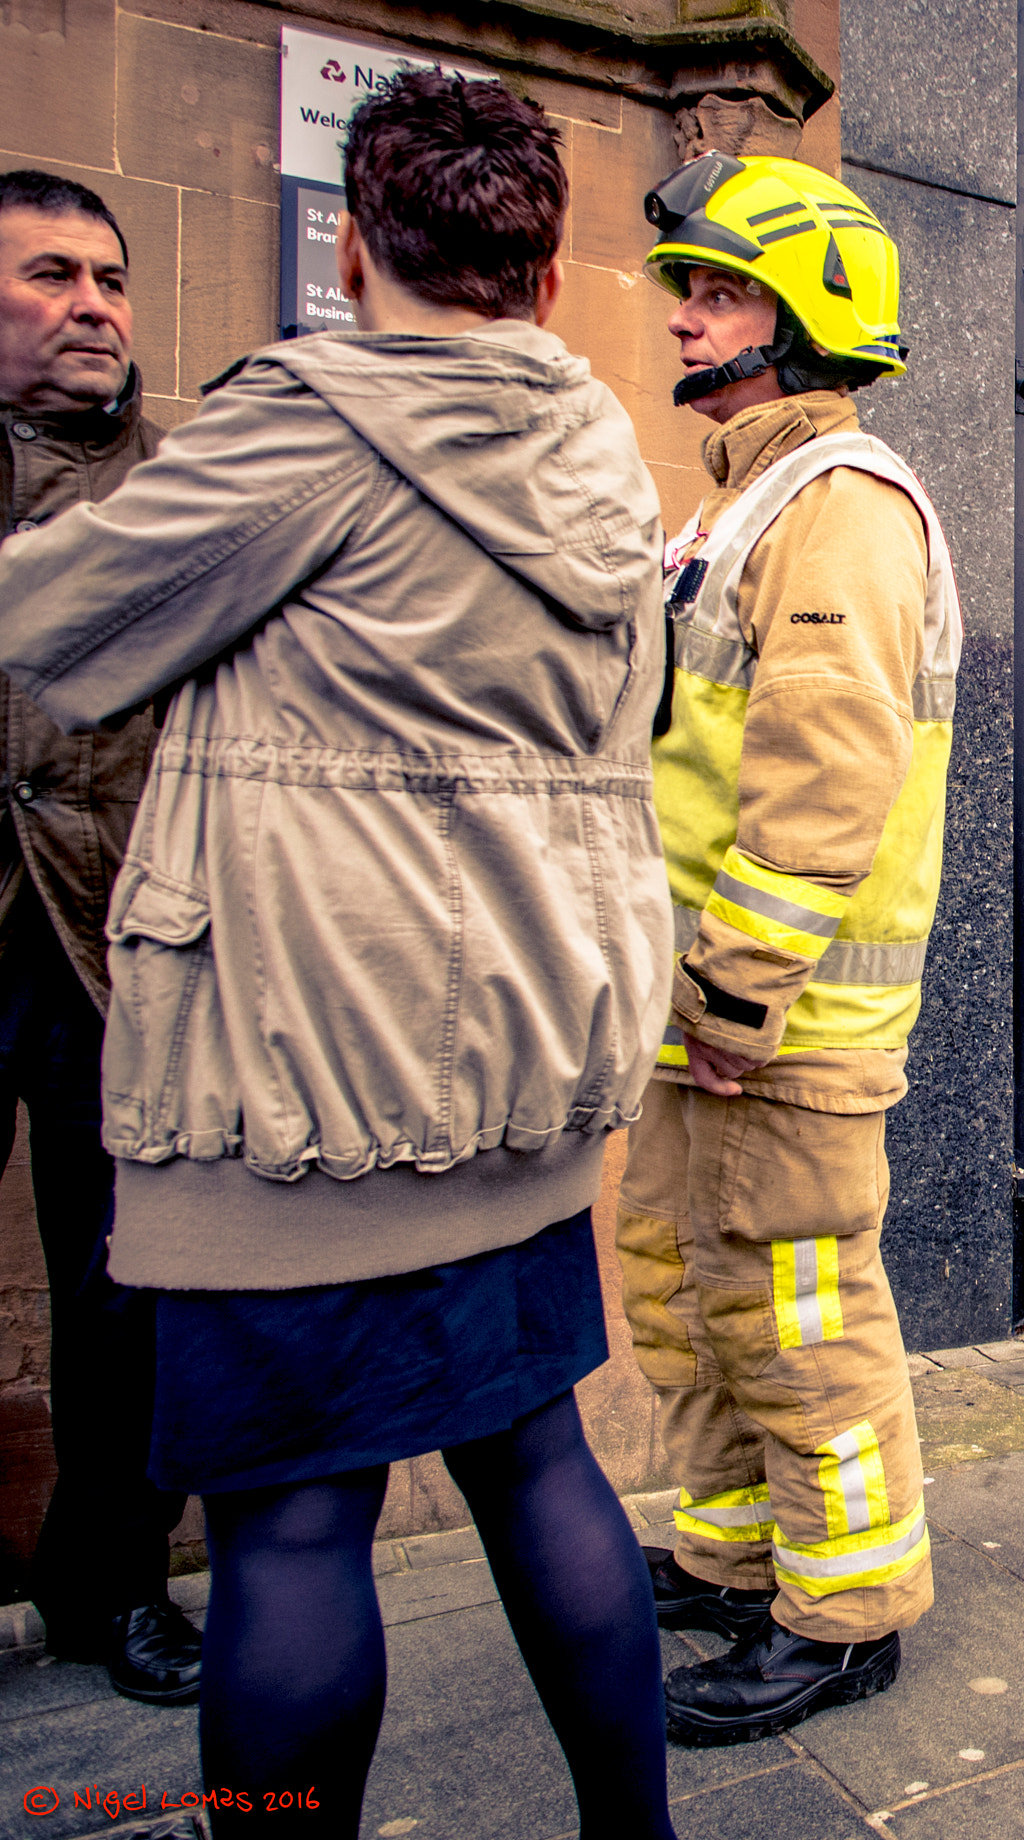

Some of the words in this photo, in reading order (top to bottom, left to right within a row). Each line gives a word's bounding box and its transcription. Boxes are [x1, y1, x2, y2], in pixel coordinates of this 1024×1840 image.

[354, 64, 392, 91] Na
[306, 208, 323, 223] St
[306, 283, 323, 299] St
[790, 611, 847, 624] COSALT
